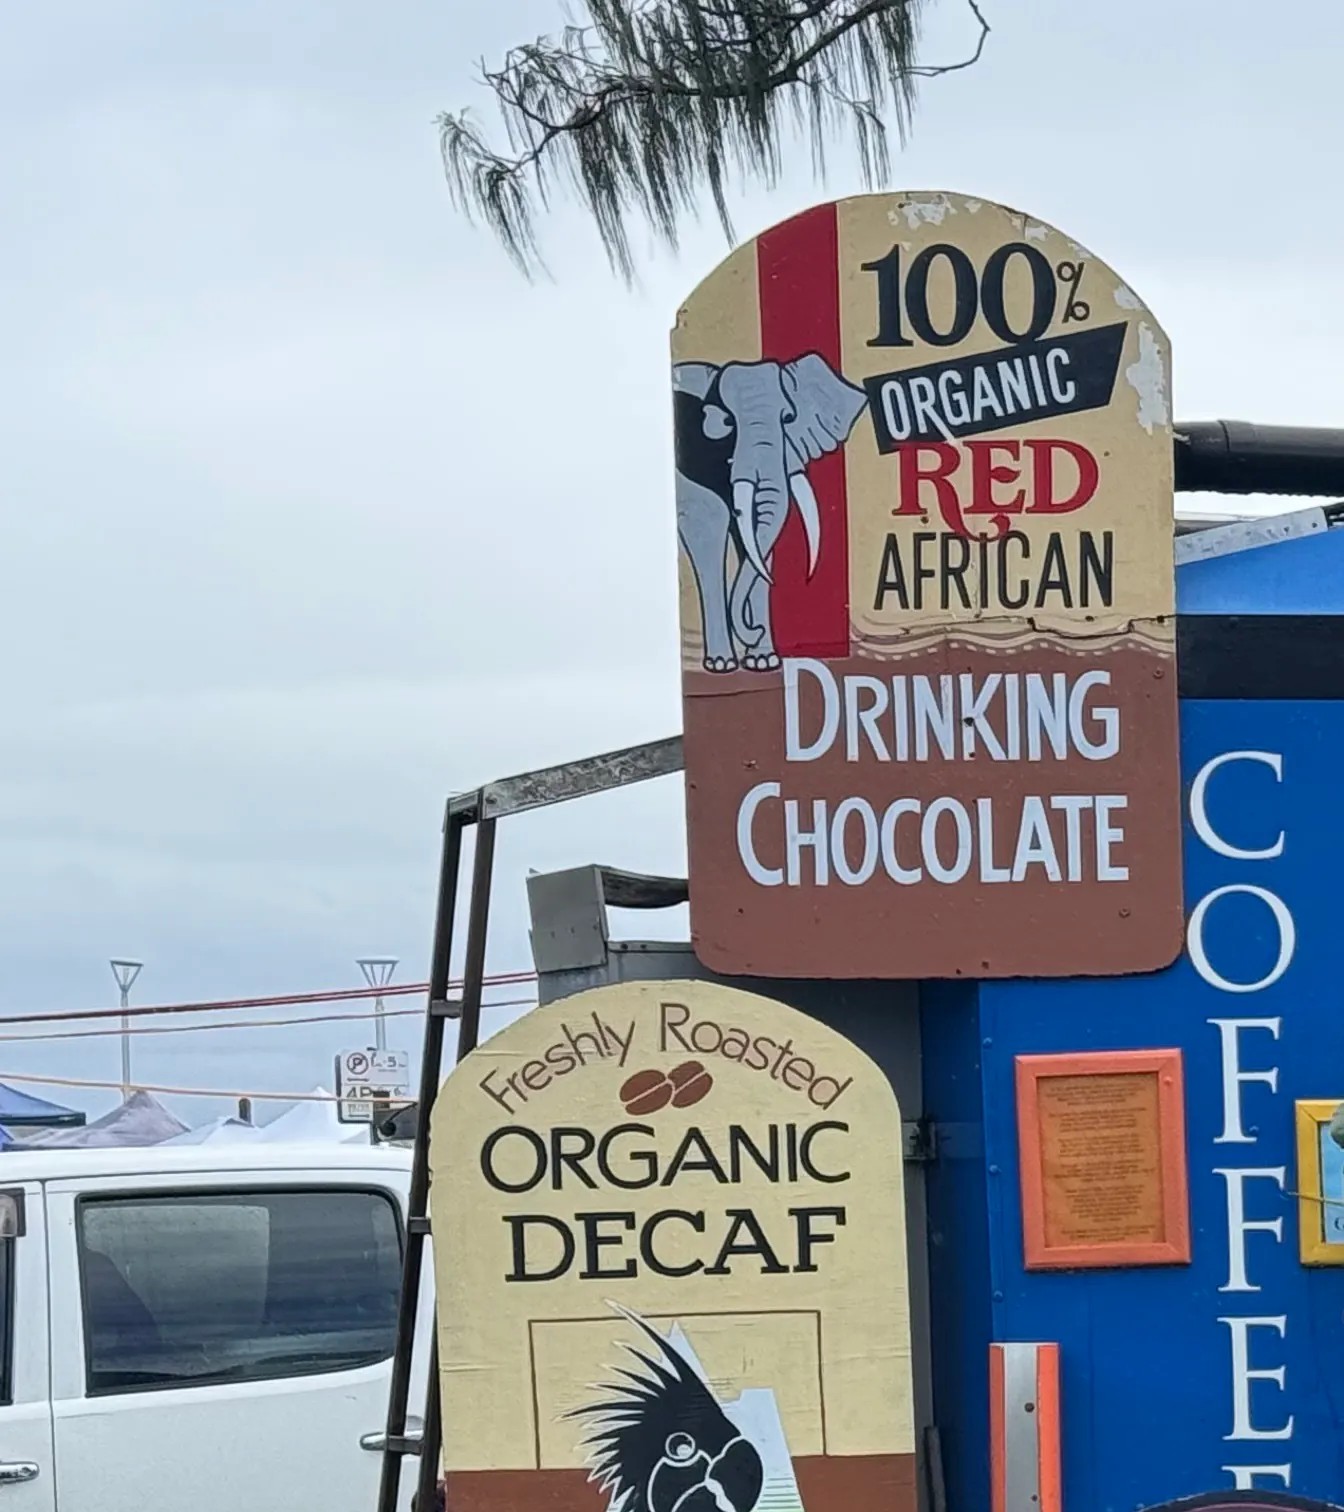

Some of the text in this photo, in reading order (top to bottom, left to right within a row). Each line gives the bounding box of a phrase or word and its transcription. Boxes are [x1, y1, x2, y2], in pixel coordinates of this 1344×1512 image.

[861, 242, 1090, 348] 100%
[880, 347, 1076, 444] ORGANIC
[892, 438, 1100, 541] RED
[873, 530, 1114, 612] AFRICAN
[782, 656, 1121, 763] DRINKING
[737, 782, 1130, 887] CHOCOLATE
[477, 1002, 853, 1116] Freshly Roasted
[480, 1120, 851, 1194] ORGANIC
[1187, 751, 1296, 1490] COFFE
[501, 1206, 847, 1284] DECAF
